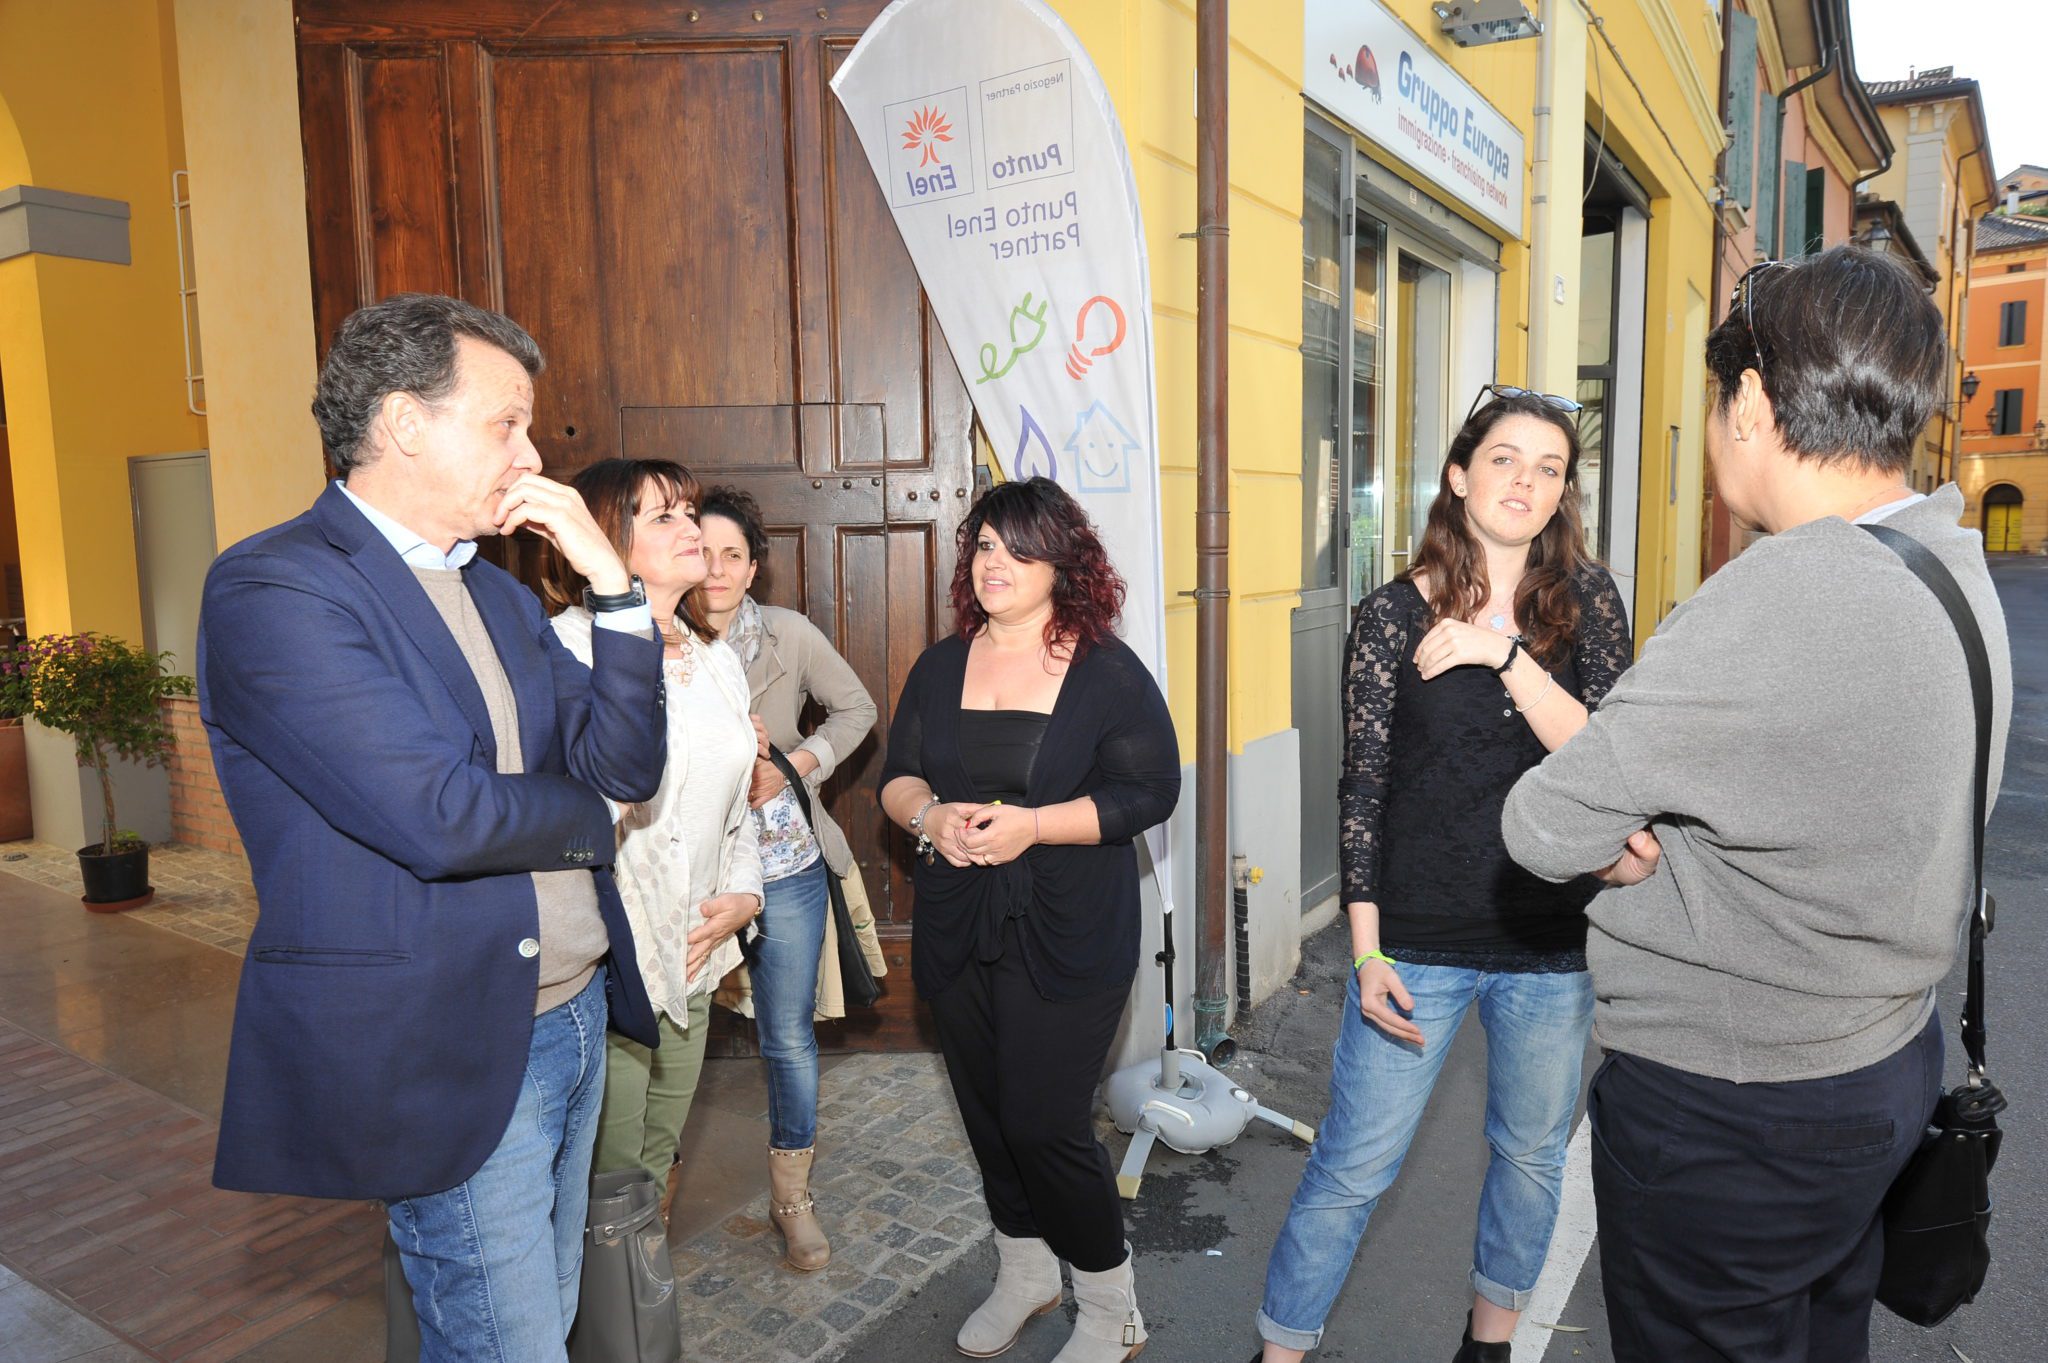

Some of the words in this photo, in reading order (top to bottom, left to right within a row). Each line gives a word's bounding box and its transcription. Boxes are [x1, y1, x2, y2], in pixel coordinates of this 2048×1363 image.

[1398, 50, 1458, 136] Gruppo
[1463, 106, 1510, 181] Europa
[1398, 107, 1447, 161] immigrazione
[1452, 149, 1485, 196] franchising
[1486, 184, 1508, 210] network
